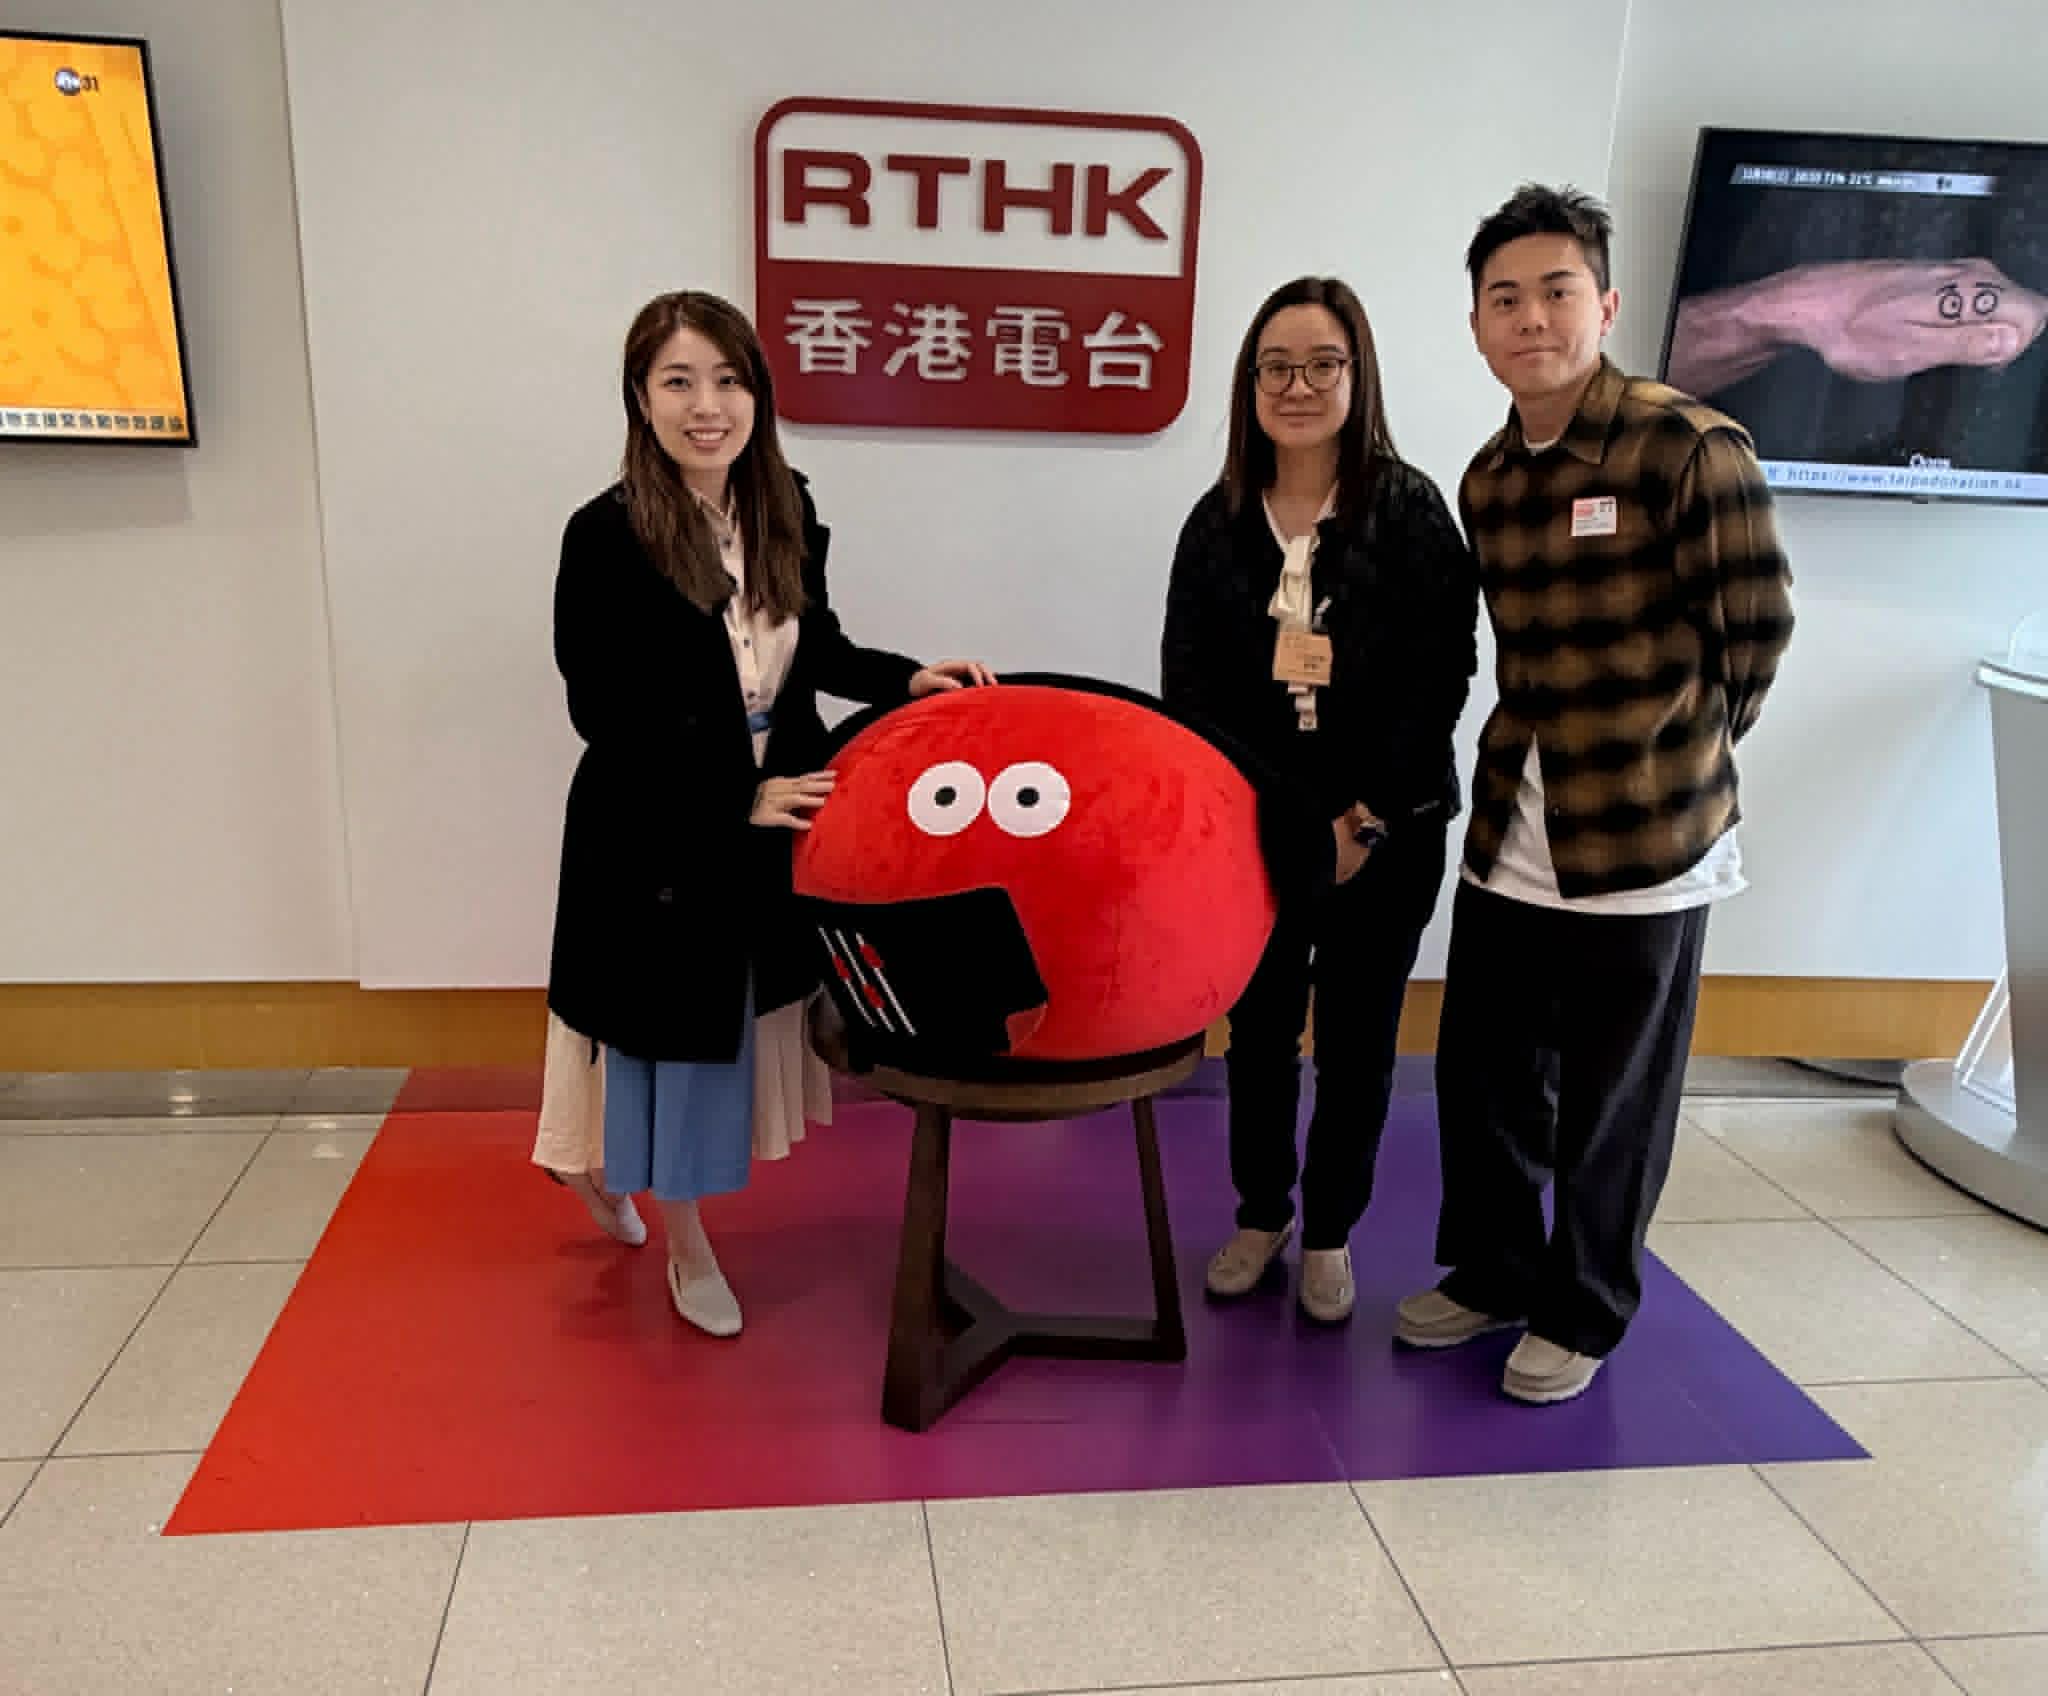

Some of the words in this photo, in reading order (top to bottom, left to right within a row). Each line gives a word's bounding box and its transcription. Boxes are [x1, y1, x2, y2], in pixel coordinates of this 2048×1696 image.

[782, 148, 1173, 242] RTHK
[784, 298, 1164, 391] 香港電台
